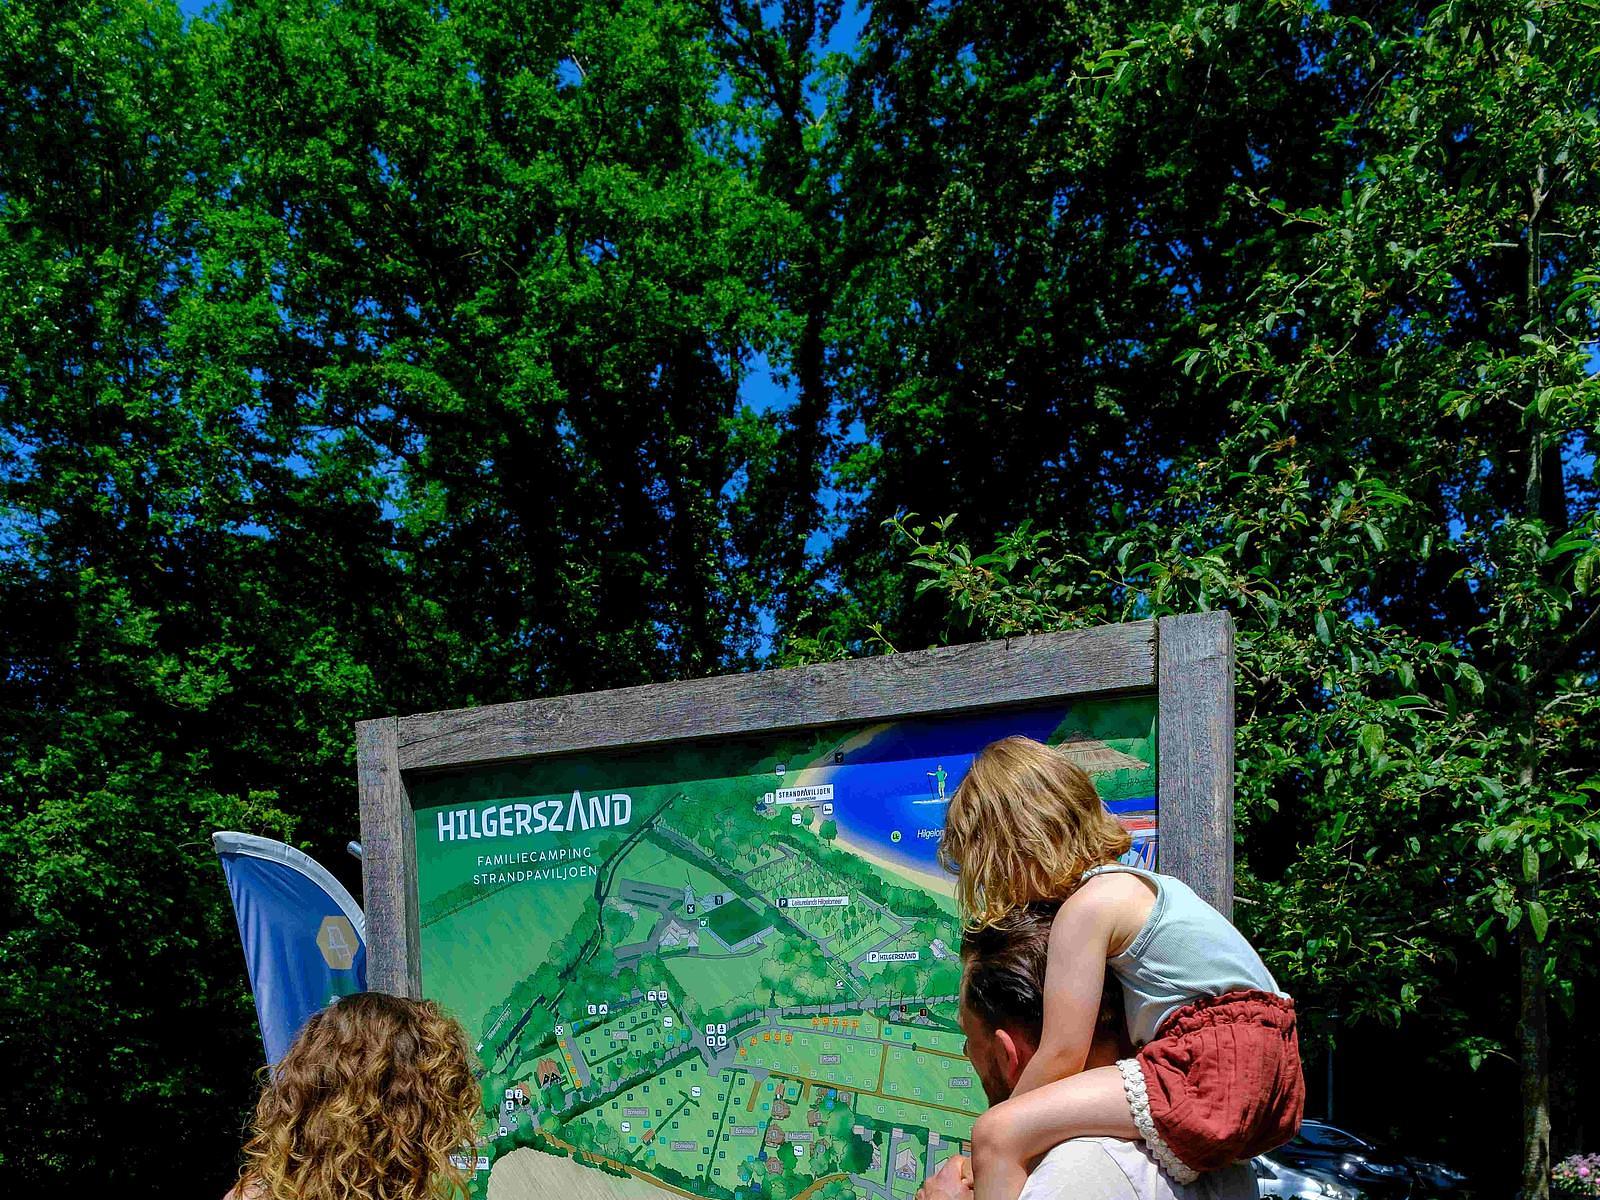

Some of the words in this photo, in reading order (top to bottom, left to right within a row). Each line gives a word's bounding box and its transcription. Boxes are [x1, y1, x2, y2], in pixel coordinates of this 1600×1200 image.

[778, 787, 831, 799] STRANDPAVILJOEN
[438, 789, 632, 842] HILGERSZAND
[477, 847, 592, 867] FAMILIECAMPING
[473, 865, 597, 886] STRANDPAVILJOEN
[879, 952, 917, 961] HILGERSZAND
